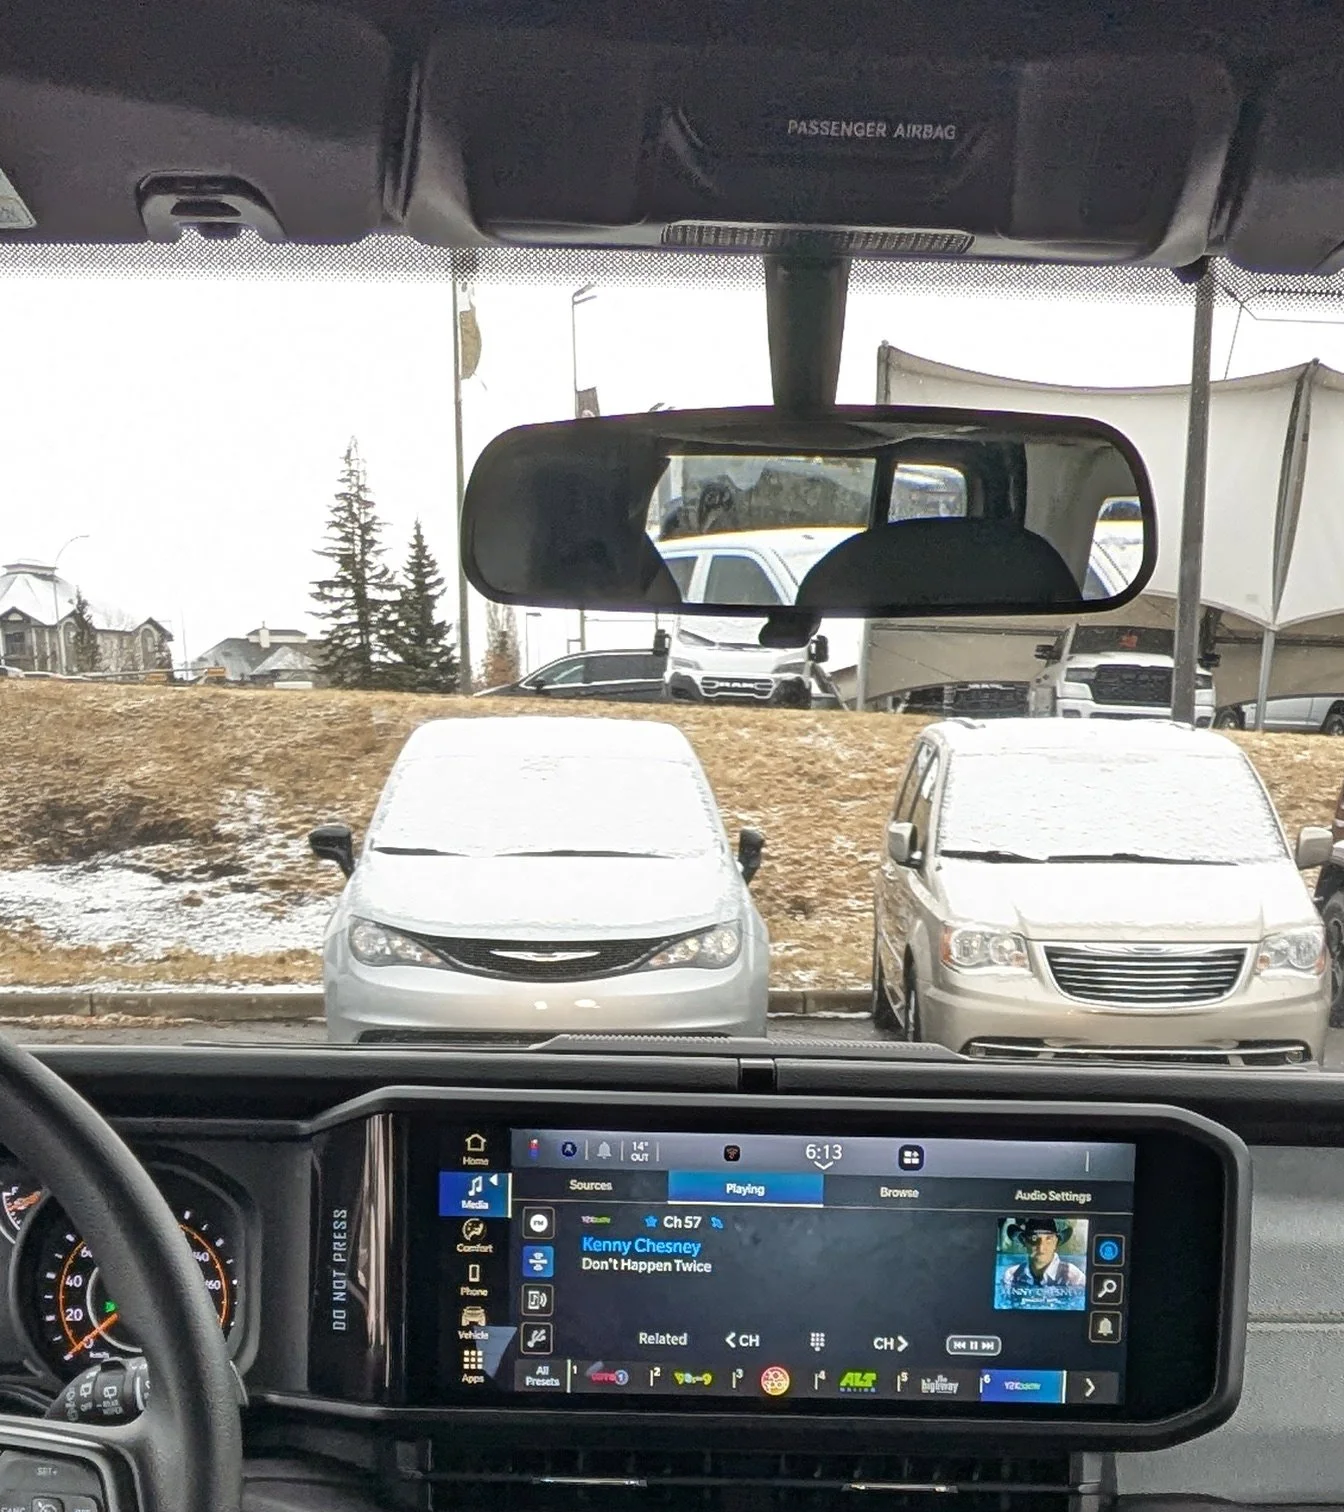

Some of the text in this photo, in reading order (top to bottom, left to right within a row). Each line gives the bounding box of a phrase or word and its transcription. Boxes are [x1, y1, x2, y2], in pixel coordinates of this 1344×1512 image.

[787, 119, 957, 141] PASSENGER AIRBAG
[630, 1153, 649, 1162] OUT
[806, 1143, 843, 1160] 6:13
[462, 1156, 490, 1166] Home
[569, 1179, 613, 1191] Sources
[726, 1183, 765, 1197] Playing
[879, 1186, 920, 1199] Browse
[1015, 1190, 1092, 1204] Audio Settings
[461, 1199, 489, 1209] Media
[663, 1215, 702, 1229] Ch 57
[456, 1243, 494, 1254] Comfort
[582, 1236, 702, 1257] Kenny Chesney
[332, 1208, 348, 1331] DO NOT PRESS
[581, 1257, 713, 1274] Don't Happen Twice
[65, 1276, 83, 1288] 40
[460, 1286, 488, 1297] Phone
[65, 1308, 83, 1322] 20
[457, 1329, 489, 1341] Vehicle
[638, 1332, 688, 1346] Related
[739, 1335, 760, 1347] CH
[873, 1337, 895, 1350] CH
[535, 1365, 549, 1376] All
[653, 1367, 661, 1377] 2
[735, 1368, 744, 1379] 3
[817, 1370, 826, 1380] 4
[461, 1373, 485, 1384] Apps
[525, 1376, 560, 1387] Presets
[839, 1371, 878, 1387] ALT
[983, 1374, 991, 1384] 6
